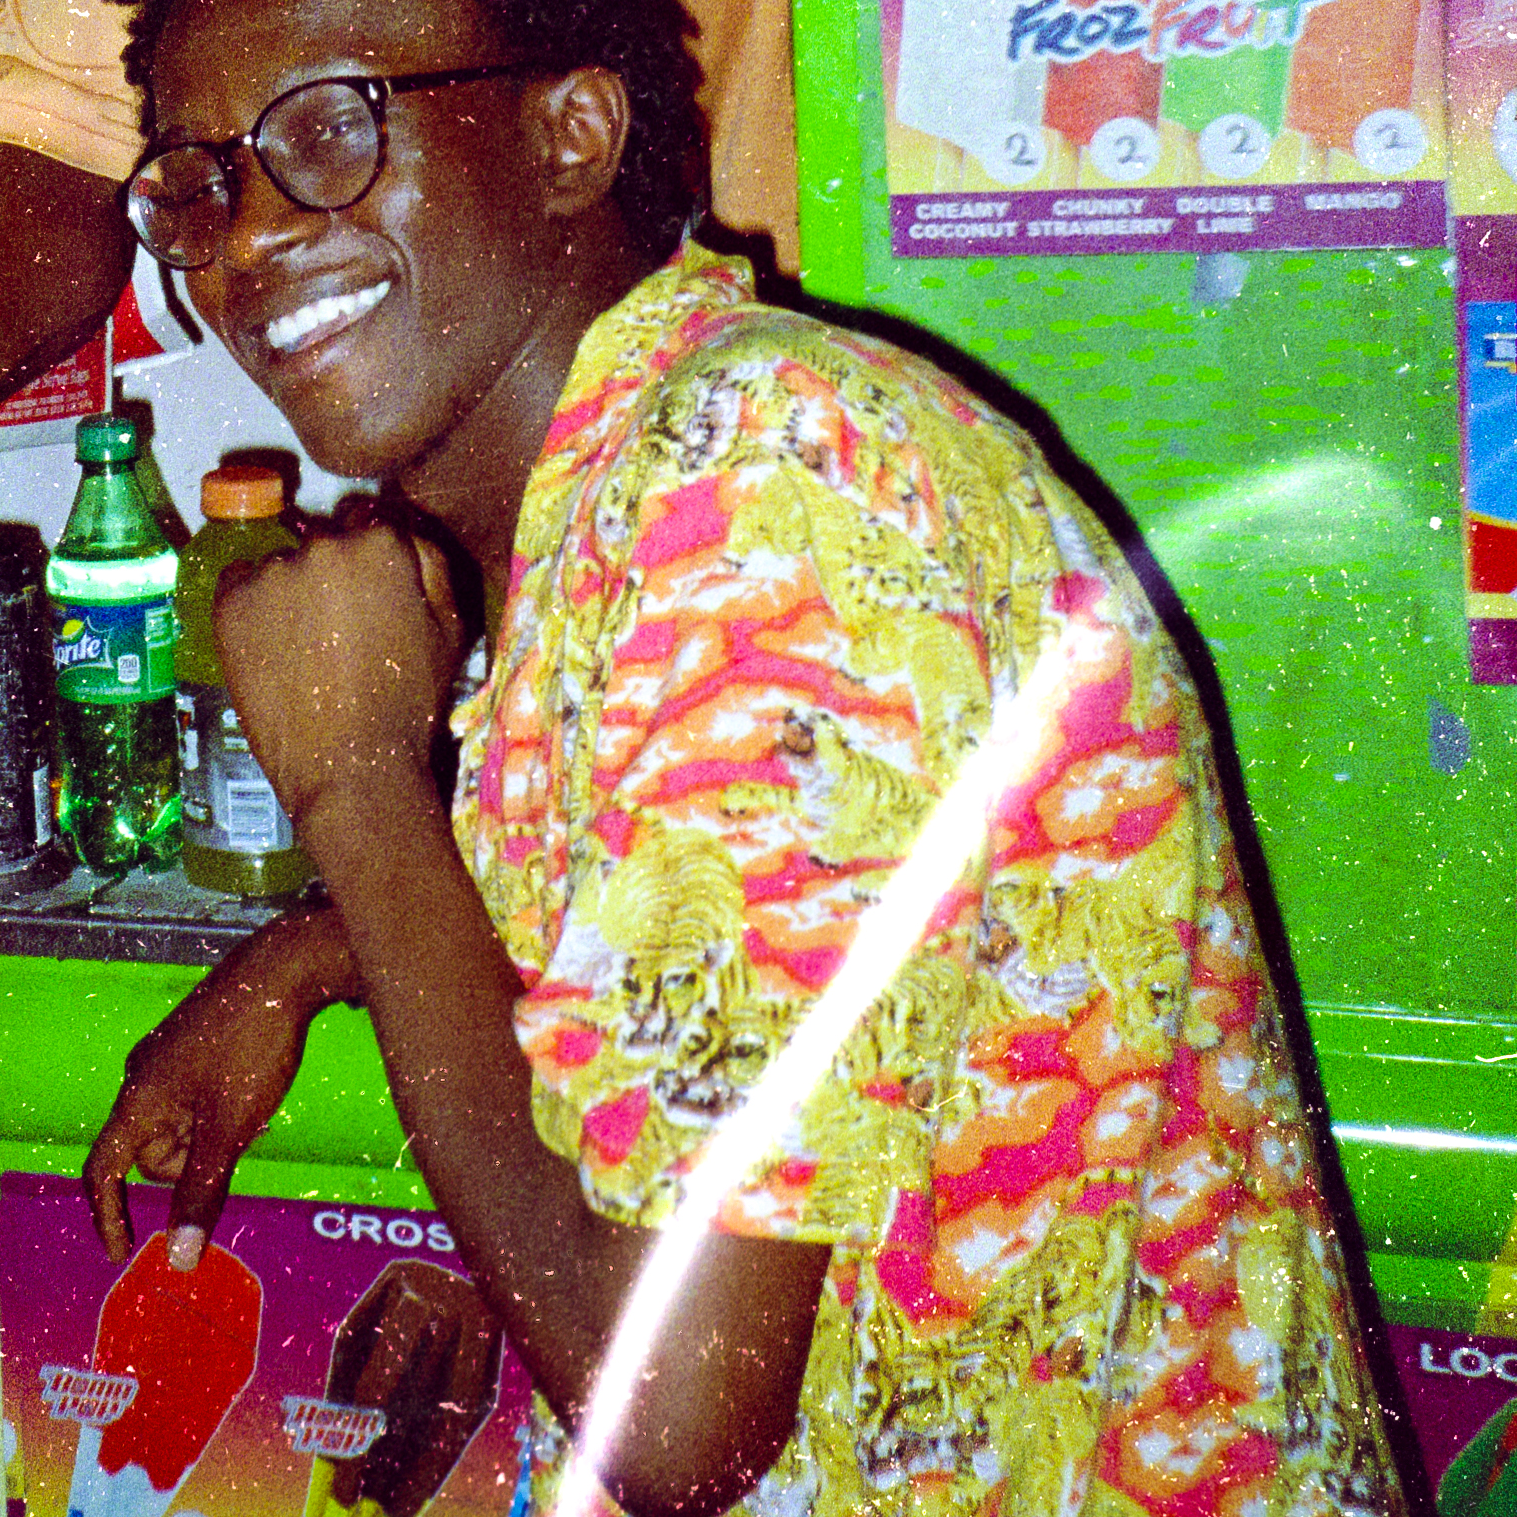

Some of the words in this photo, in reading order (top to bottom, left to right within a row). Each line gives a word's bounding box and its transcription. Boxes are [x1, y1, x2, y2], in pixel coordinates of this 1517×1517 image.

[1226, 124, 1256, 154] 2
[1004, 133, 1036, 166] 2
[1117, 135, 1143, 164] 2
[1052, 197, 1146, 216] CHUNKY
[1176, 194, 1275, 216] DOUBLE
[1304, 191, 1402, 210] MANGO
[916, 202, 1010, 221] CREAMY
[908, 221, 1019, 239] COCONUT
[1026, 217, 1175, 237] STRAWBERRY
[1197, 216, 1255, 234] LIME
